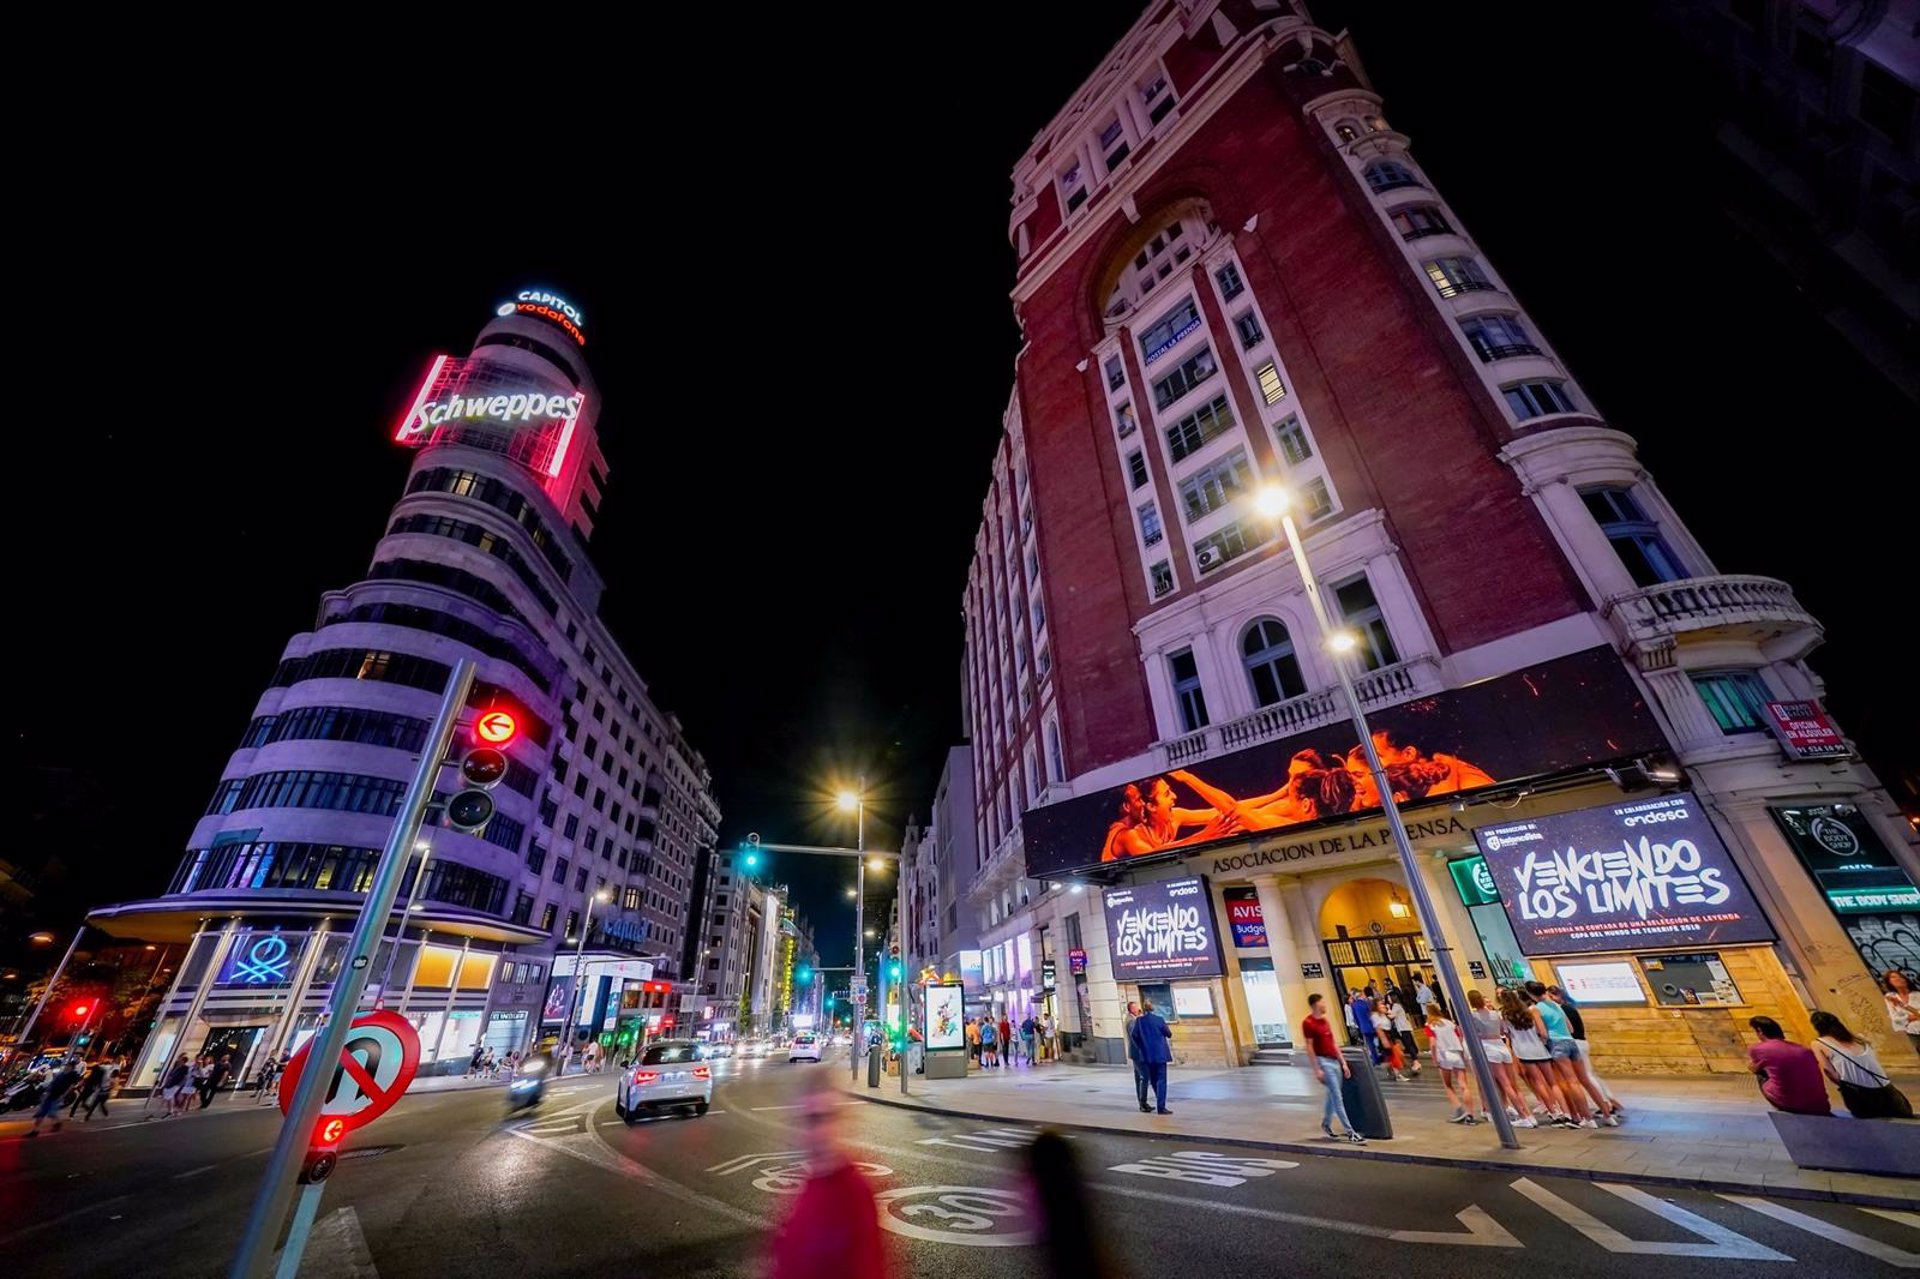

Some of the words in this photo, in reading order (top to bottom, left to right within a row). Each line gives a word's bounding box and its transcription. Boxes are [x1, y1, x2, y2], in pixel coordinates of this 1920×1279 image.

[517, 303, 586, 346] vodafone
[518, 291, 582, 327] CAPITOL
[1147, 345, 1168, 364] HOSTAL
[1168, 338, 1177, 347] LA
[1177, 320, 1201, 340] PRENSA
[408, 393, 580, 433] Schweppes
[1785, 730, 1799, 739] EN
[1798, 727, 1835, 738] ALQUILER
[1789, 721, 1821, 730] OFICINA
[1624, 809, 1689, 827] endesa
[1212, 843, 1315, 874] ASOCIACION
[1319, 837, 1346, 856] DE
[1349, 833, 1377, 849] LA
[1379, 816, 1466, 844] PENSA
[1824, 834, 1850, 842] BODY
[1830, 841, 1853, 849] SHOP
[1513, 835, 1701, 894] VENCIENDO
[1518, 885, 1578, 920] LOS
[1586, 867, 1730, 920] LIMITES
[1831, 896, 1857, 908] THE
[1855, 894, 1888, 906] BODY
[1887, 893, 1919, 905] SHOP
[1117, 903, 1199, 941] VENCIENDO
[1234, 905, 1262, 918] AVIS
[1543, 926, 1574, 935] HISTORIA
[1585, 923, 1618, 931] CONTADA
[1629, 920, 1646, 928] UNA
[1702, 913, 1741, 921] LEYENDA
[1116, 933, 1142, 956] LOS
[1147, 927, 1208, 959] LIMITES
[1236, 924, 1265, 936] Budge
[1604, 929, 1630, 937] MUNDO
[1643, 925, 1680, 934] TENERIFE
[1107, 1151, 1300, 1188] BUS
[900, 1195, 1026, 1230] 30
